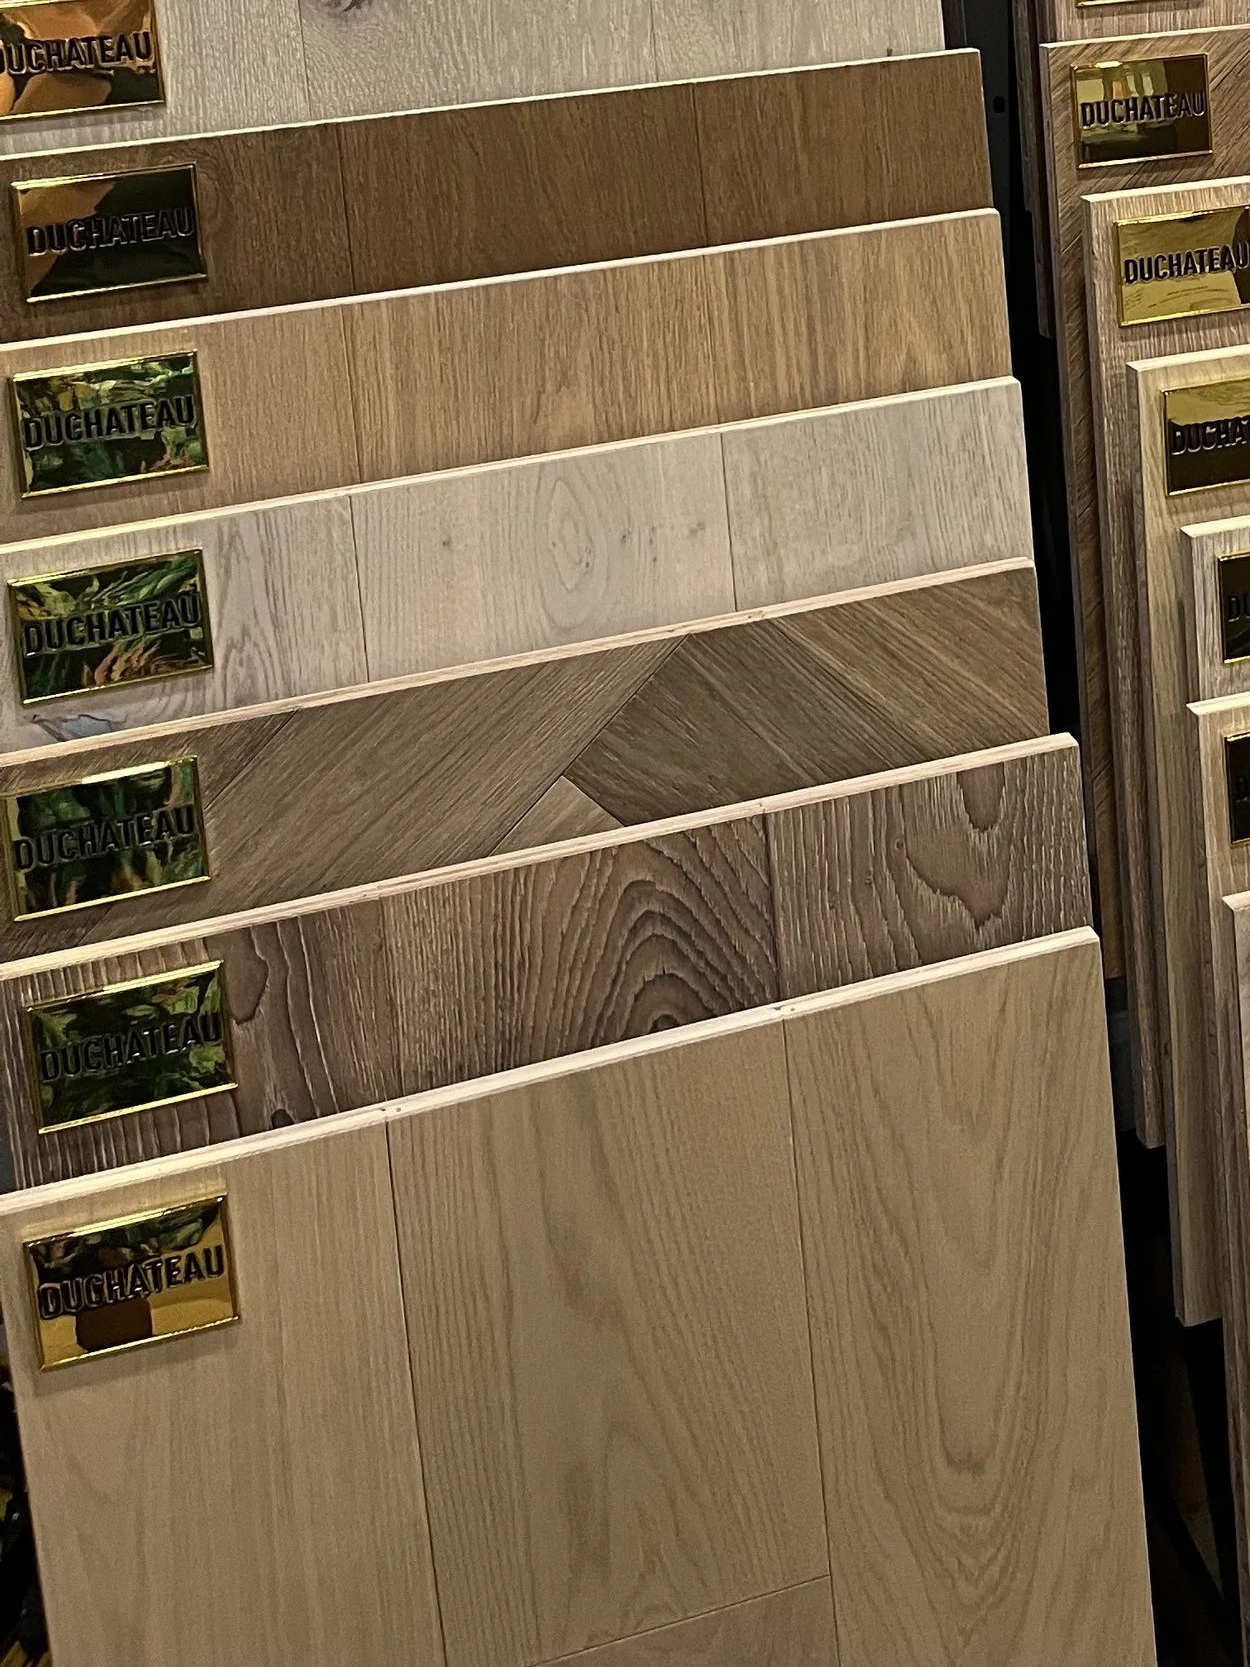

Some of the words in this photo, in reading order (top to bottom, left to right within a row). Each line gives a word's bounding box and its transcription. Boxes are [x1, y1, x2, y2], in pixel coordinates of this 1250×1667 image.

[1081, 91, 1205, 129] DUCHATEAU
[27, 206, 194, 256] DUCHATEAU
[1124, 242, 1249, 284] DUCHATEAU
[24, 395, 195, 450] DUCHATEAU
[24, 593, 202, 656] DUCHATEAU
[14, 807, 196, 871] DUCHATEAU
[40, 1012, 222, 1082] DUCHATEAU
[38, 1246, 225, 1319] DUCHATEAU
